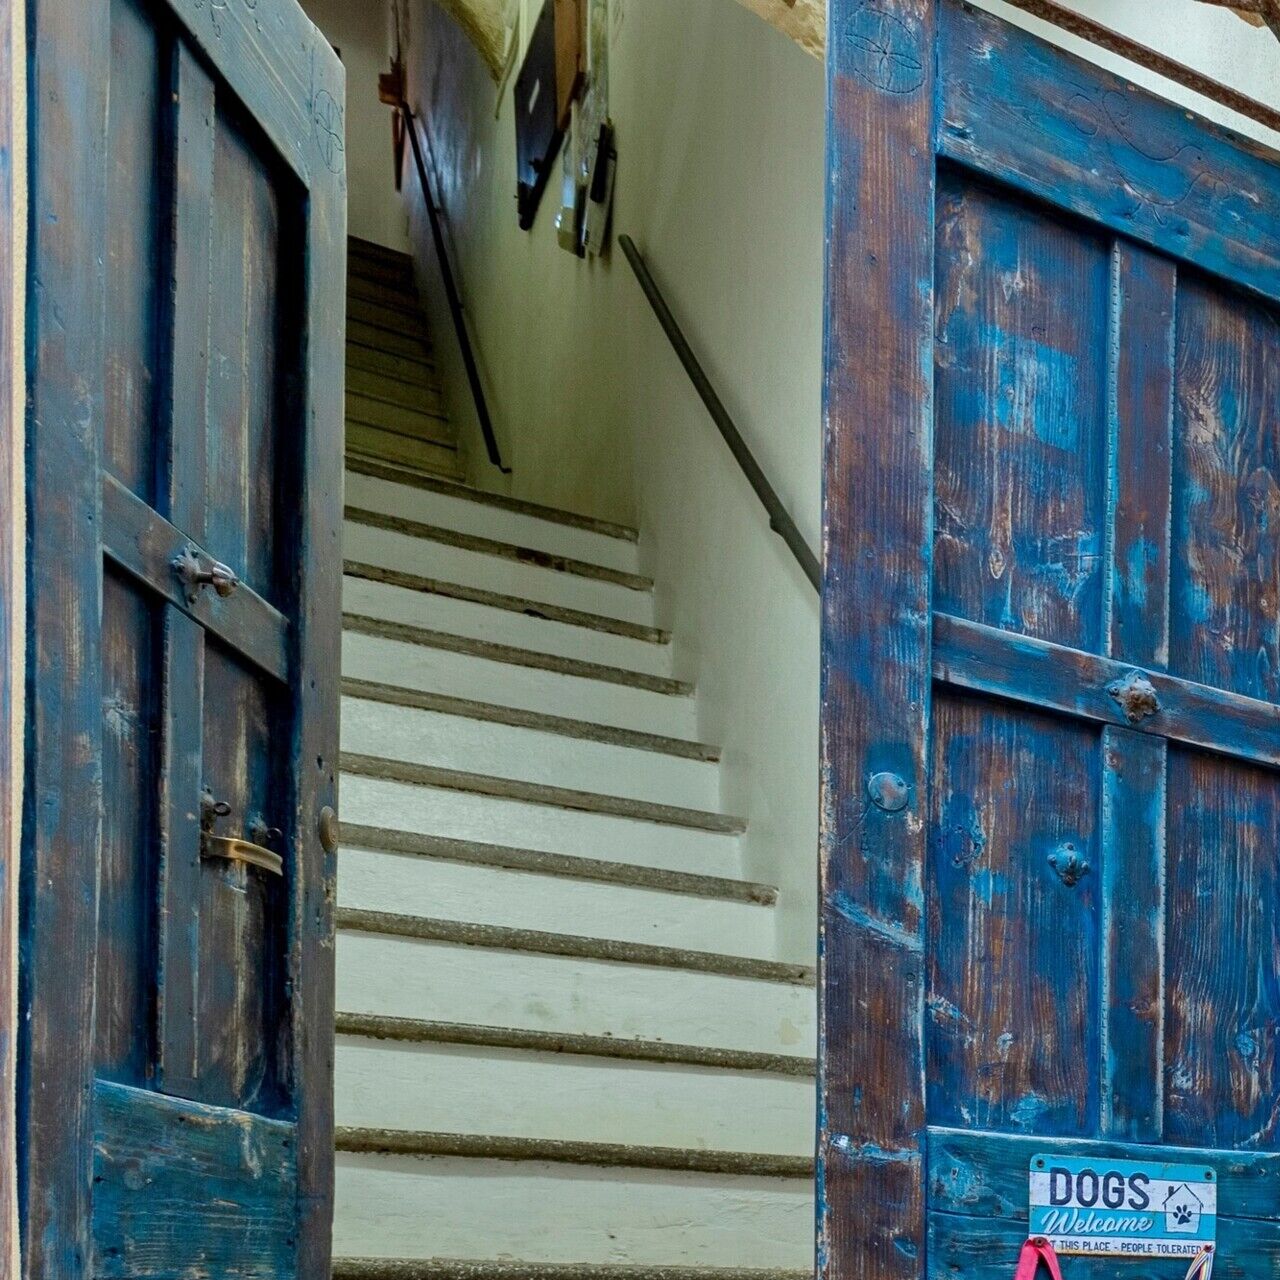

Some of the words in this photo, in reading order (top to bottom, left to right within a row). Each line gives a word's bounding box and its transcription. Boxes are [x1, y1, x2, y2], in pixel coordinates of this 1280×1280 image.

[1050, 1166, 1151, 1211] DOGS
[1040, 1208, 1154, 1234] Welcome
[1060, 1240, 1080, 1251] THIS
[1083, 1241, 1111, 1252] PLACE
[1120, 1242, 1153, 1254] PEOPLE
[1156, 1243, 1203, 1256] TOLERATED
